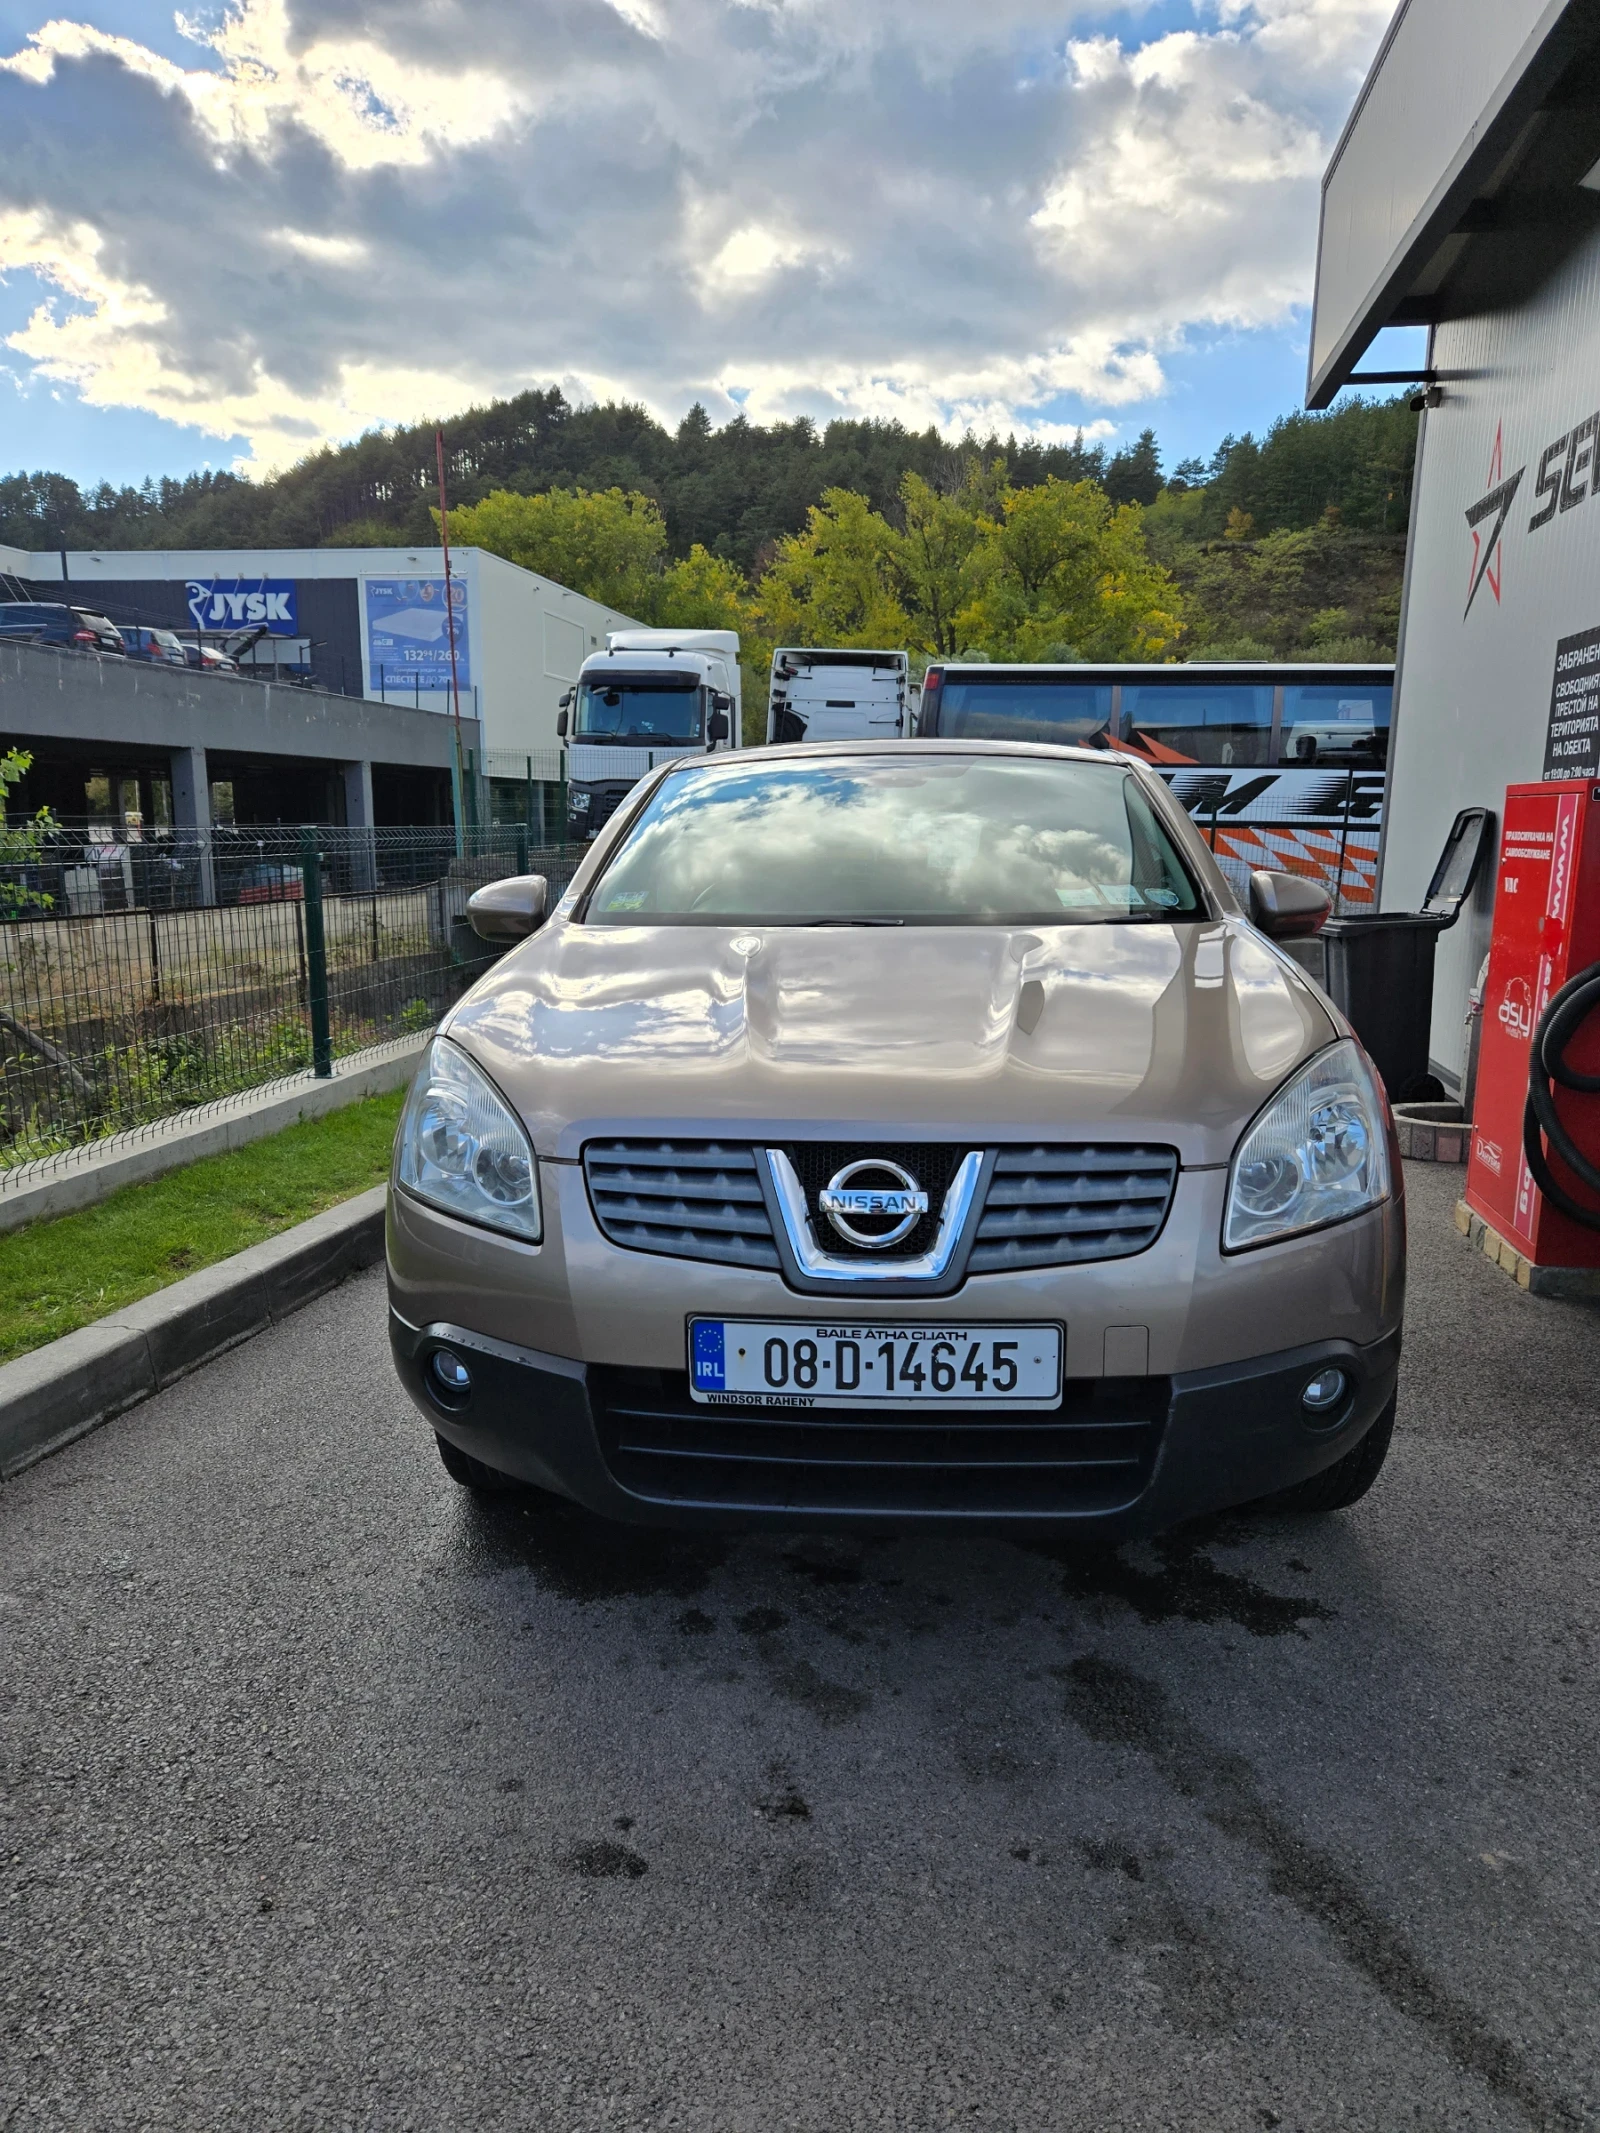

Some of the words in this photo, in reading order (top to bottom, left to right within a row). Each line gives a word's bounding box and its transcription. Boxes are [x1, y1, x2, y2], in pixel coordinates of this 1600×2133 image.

[375, 587, 393, 595] JYSK
[209, 593, 293, 620] JYSK
[1555, 694, 1587, 717] ПРЕСТОЙ
[1588, 695, 1598, 711] НА
[1551, 715, 1598, 737] ТЕРИТОРИЯТА
[1553, 741, 1562, 757] НА
[1563, 738, 1590, 756] ОБЕКТА
[831, 1195, 917, 1209] NISSAN
[817, 1328, 862, 1339] BAILE
[911, 1331, 968, 1341] CLIATH
[697, 1361, 724, 1377] IRL
[707, 1393, 763, 1405] WINDSOR
[765, 1395, 816, 1407] RAHENY
